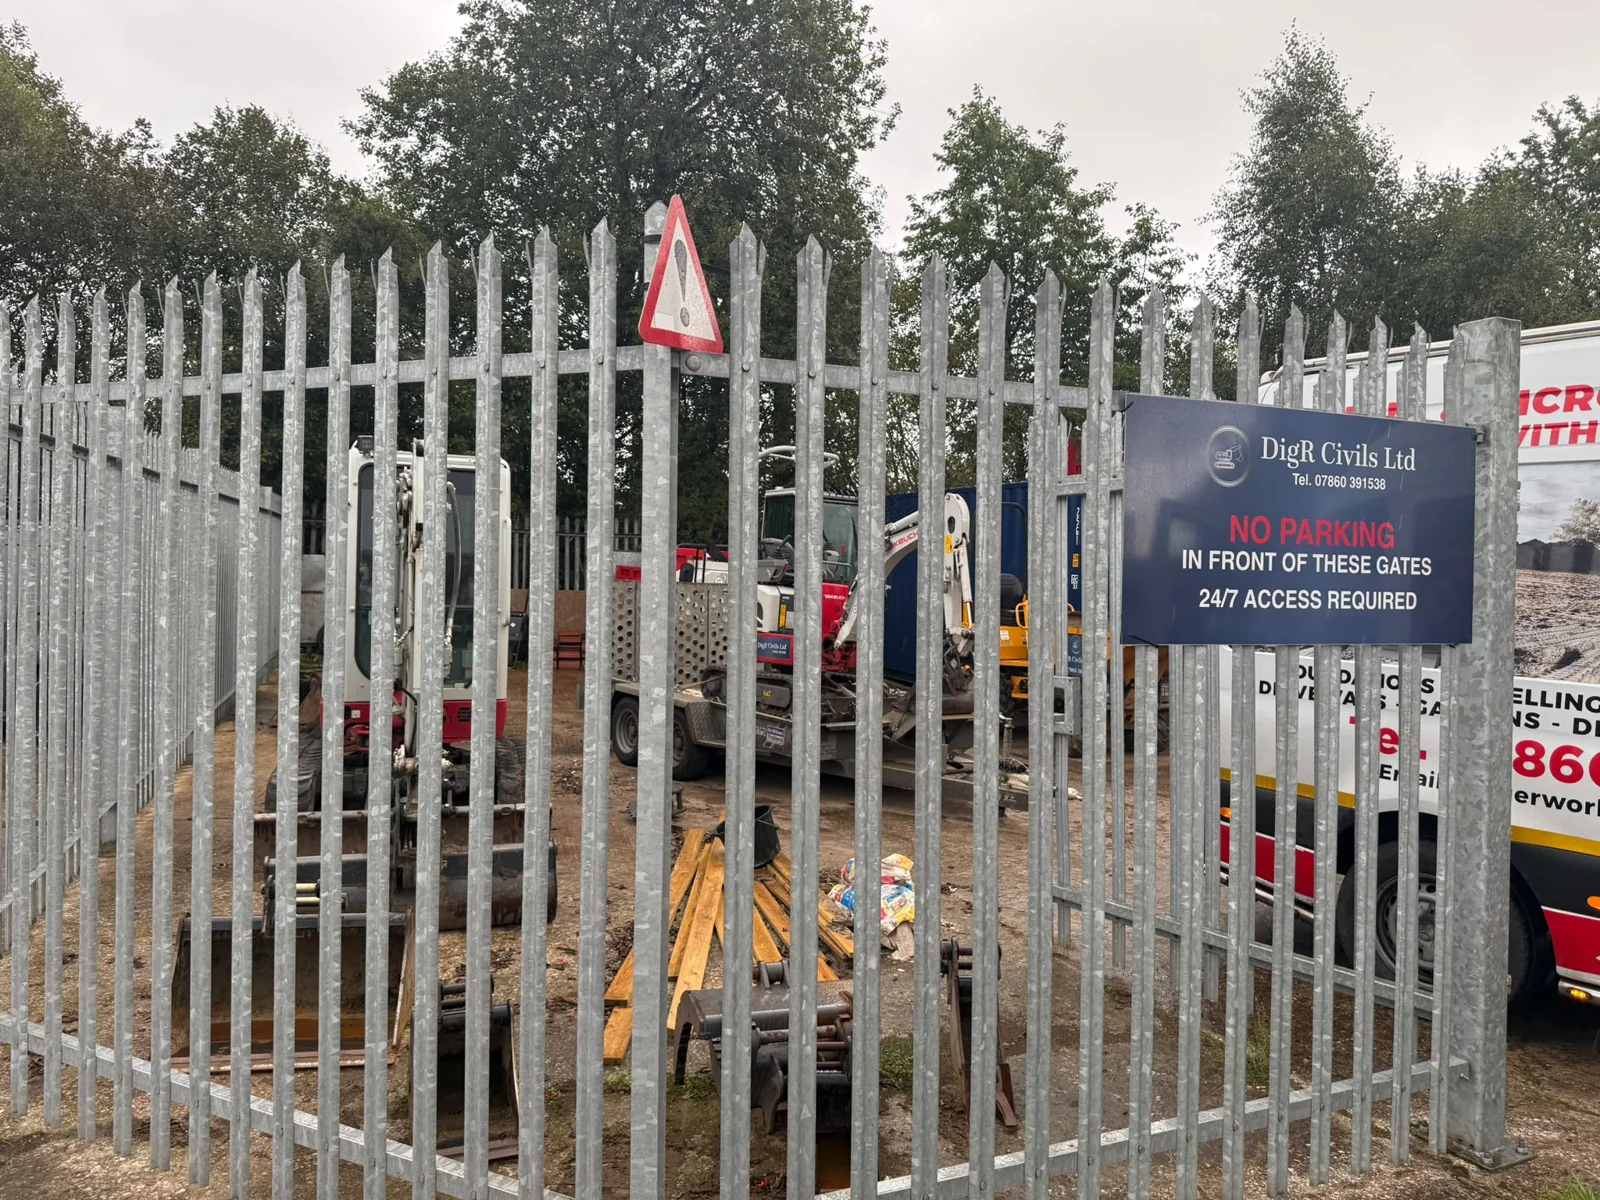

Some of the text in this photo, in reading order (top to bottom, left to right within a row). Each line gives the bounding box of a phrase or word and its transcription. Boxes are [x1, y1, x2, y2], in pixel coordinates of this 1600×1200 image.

[1518, 420, 1598, 448] ITH
[1260, 436, 1416, 471] DigR Civils Ltd
[1292, 473, 1387, 490] Tel. 07860 391538
[1230, 515, 1395, 549] NO PARKING
[1182, 549, 1432, 576] IN FRONT OF THESE GATES
[1198, 587, 1418, 610] 24/7 ACCESS REQUIRED
